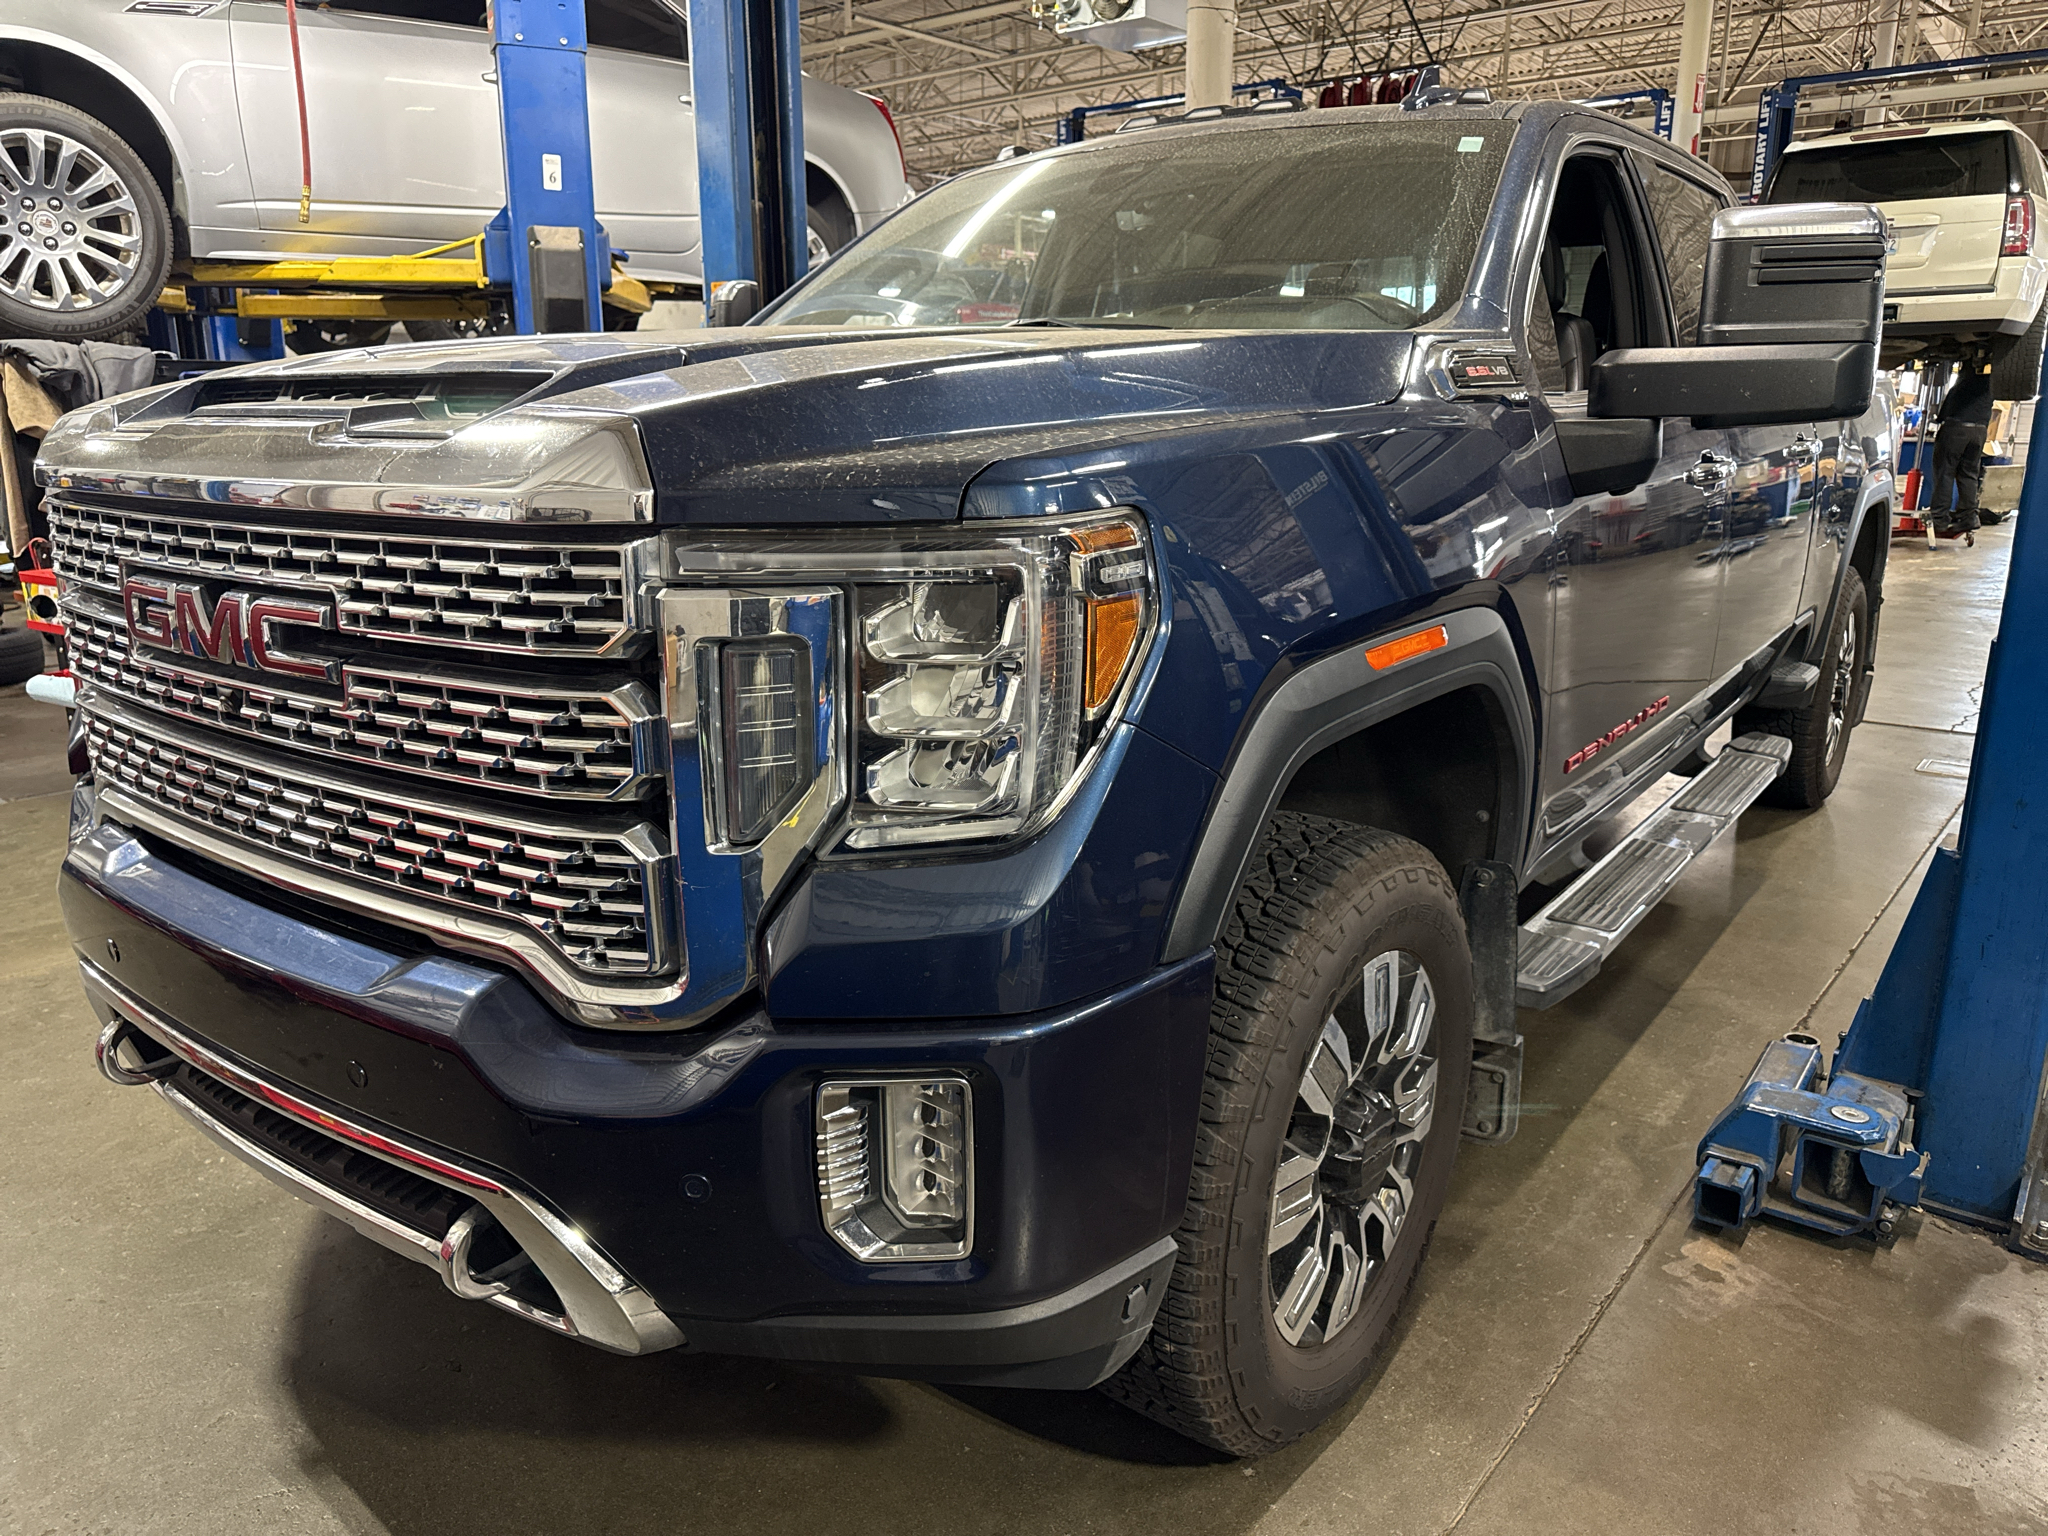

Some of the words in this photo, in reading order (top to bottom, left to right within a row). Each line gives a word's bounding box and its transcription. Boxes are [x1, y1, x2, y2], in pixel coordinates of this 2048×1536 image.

[1660, 100, 1672, 127] LIFT
[1759, 95, 1772, 128] LIFT
[549, 171, 557, 184] 6
[1752, 134, 1767, 195] ROTARY
[124, 575, 340, 685] GMC
